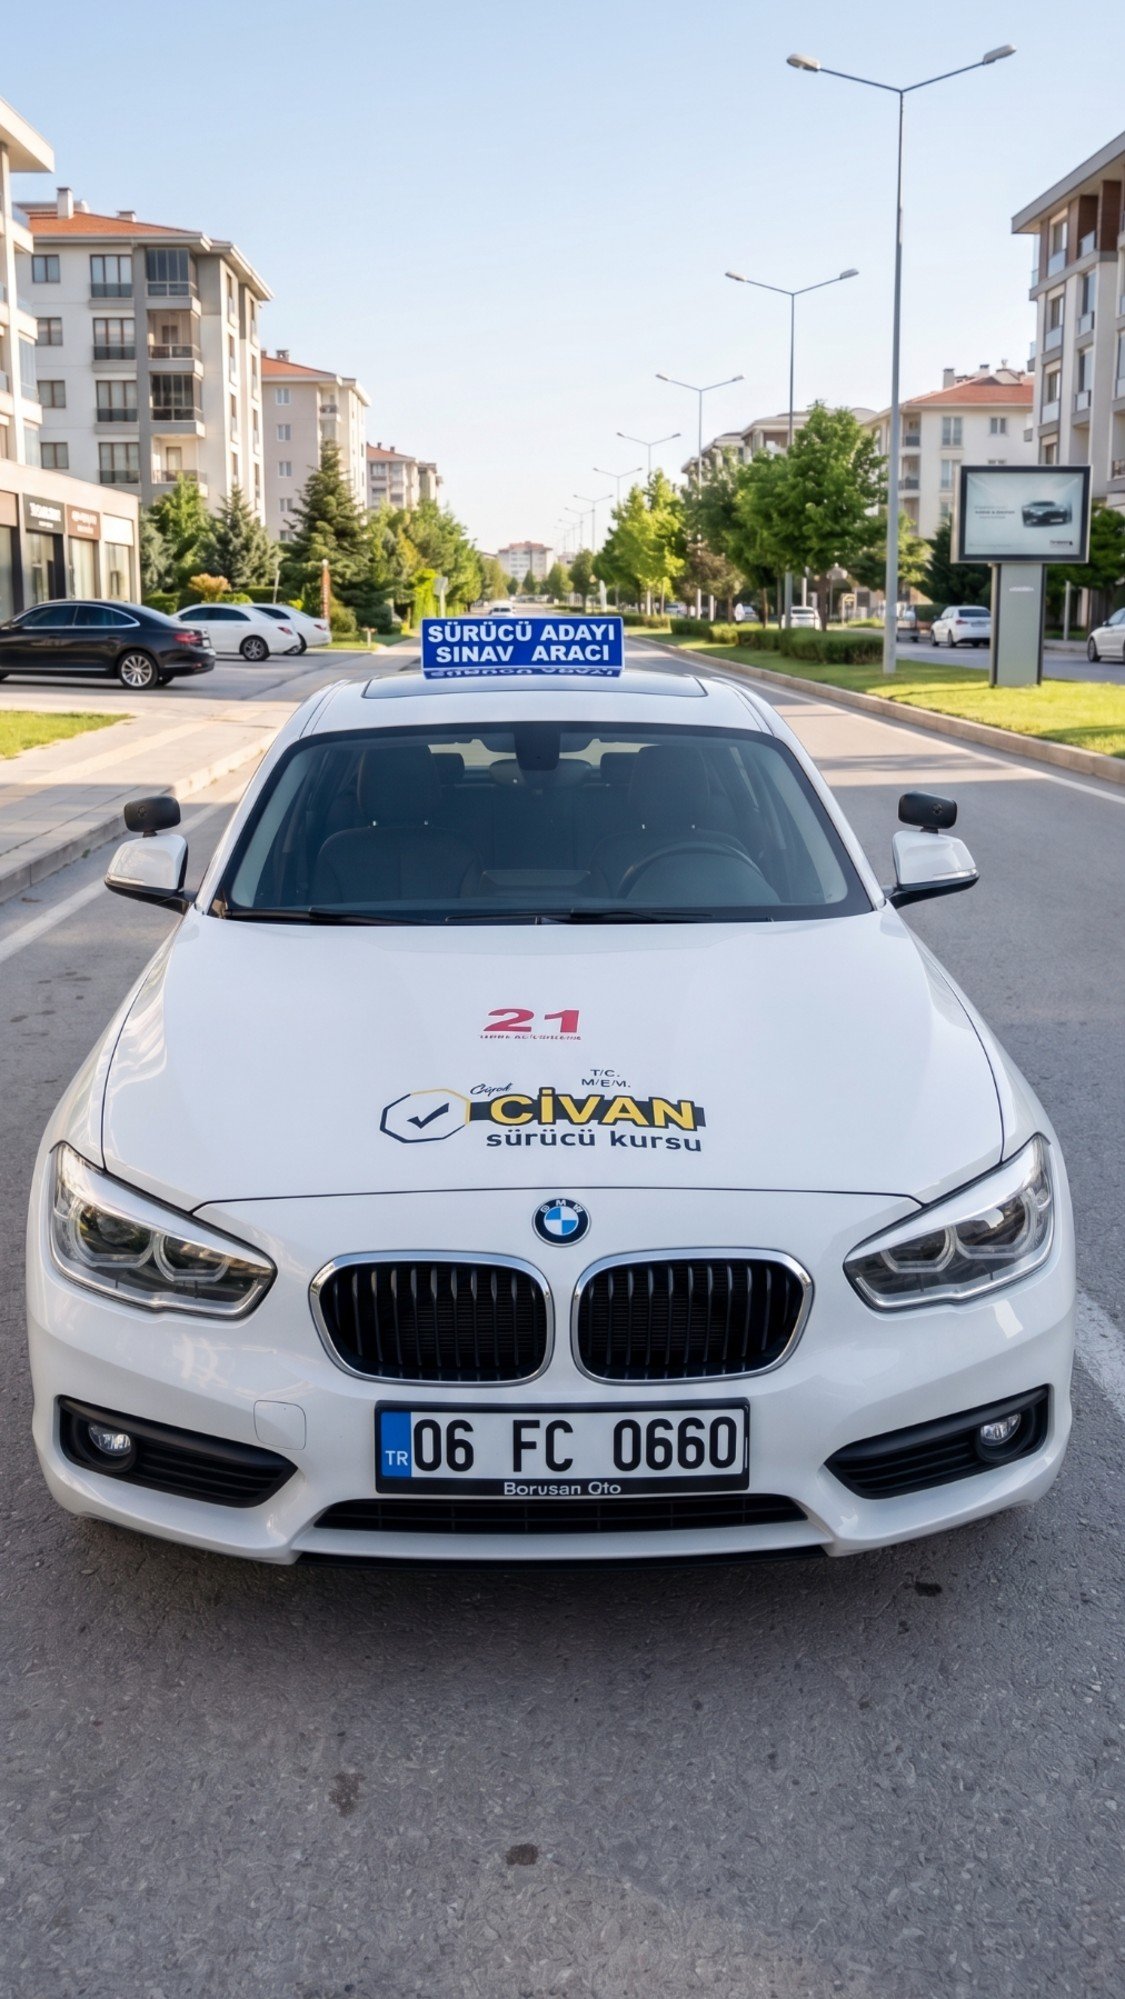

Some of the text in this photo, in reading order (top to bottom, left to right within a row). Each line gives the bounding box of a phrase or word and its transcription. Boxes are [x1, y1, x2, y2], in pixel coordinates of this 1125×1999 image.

[427, 621, 615, 642] SÜRÜCÜ ADAYI
[436, 644, 609, 663] SINAV ARACI
[483, 1008, 580, 1033] 21
[486, 1129, 702, 1152] sürücü kursu
[540, 1199, 583, 1213] BMW
[385, 1416, 737, 1472] TR 06 FC 0660
[503, 1481, 581, 1496] Borusan
